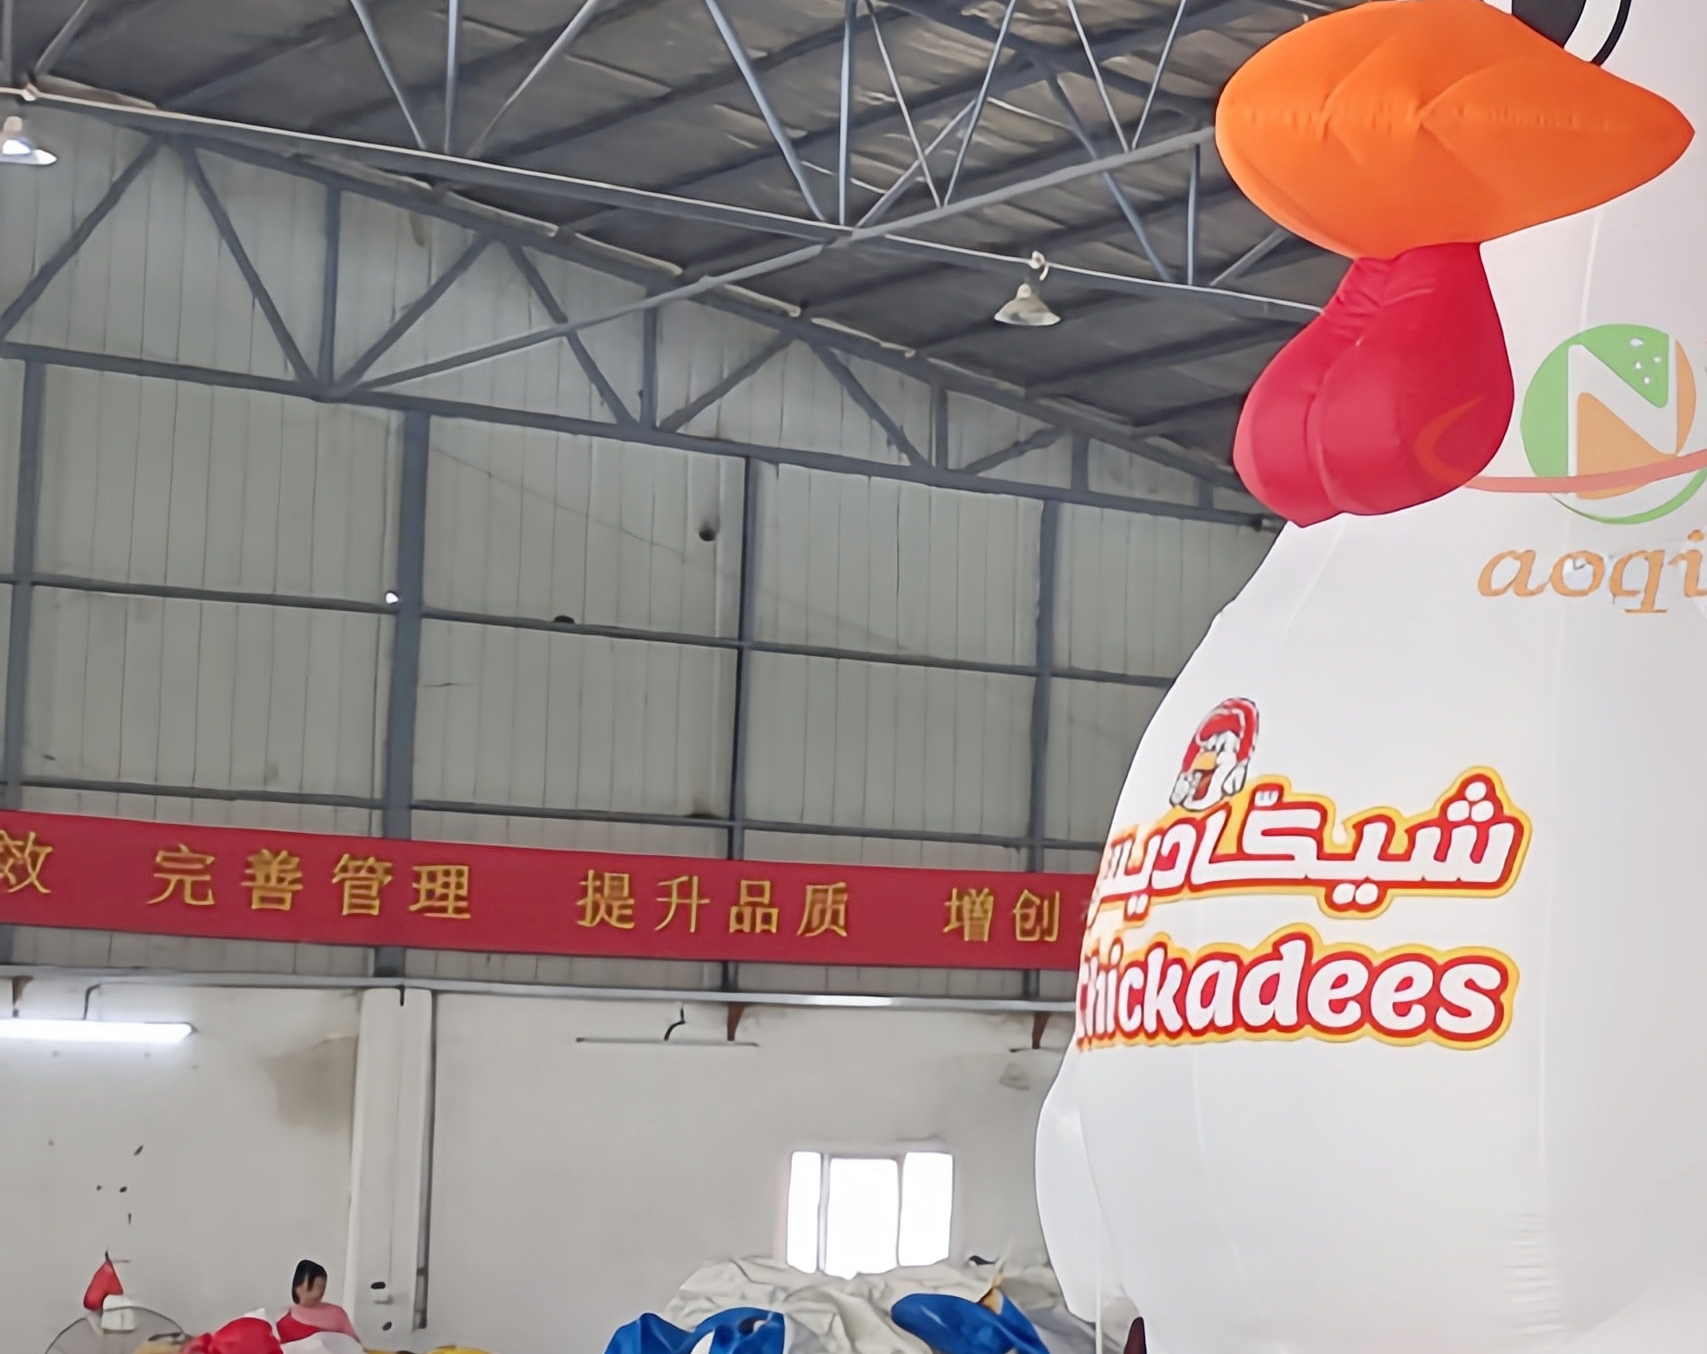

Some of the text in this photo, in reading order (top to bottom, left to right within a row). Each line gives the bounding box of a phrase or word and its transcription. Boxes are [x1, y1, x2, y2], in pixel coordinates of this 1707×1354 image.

[146, 844, 472, 920] 完善管理
[577, 870, 849, 937] 提升品质
